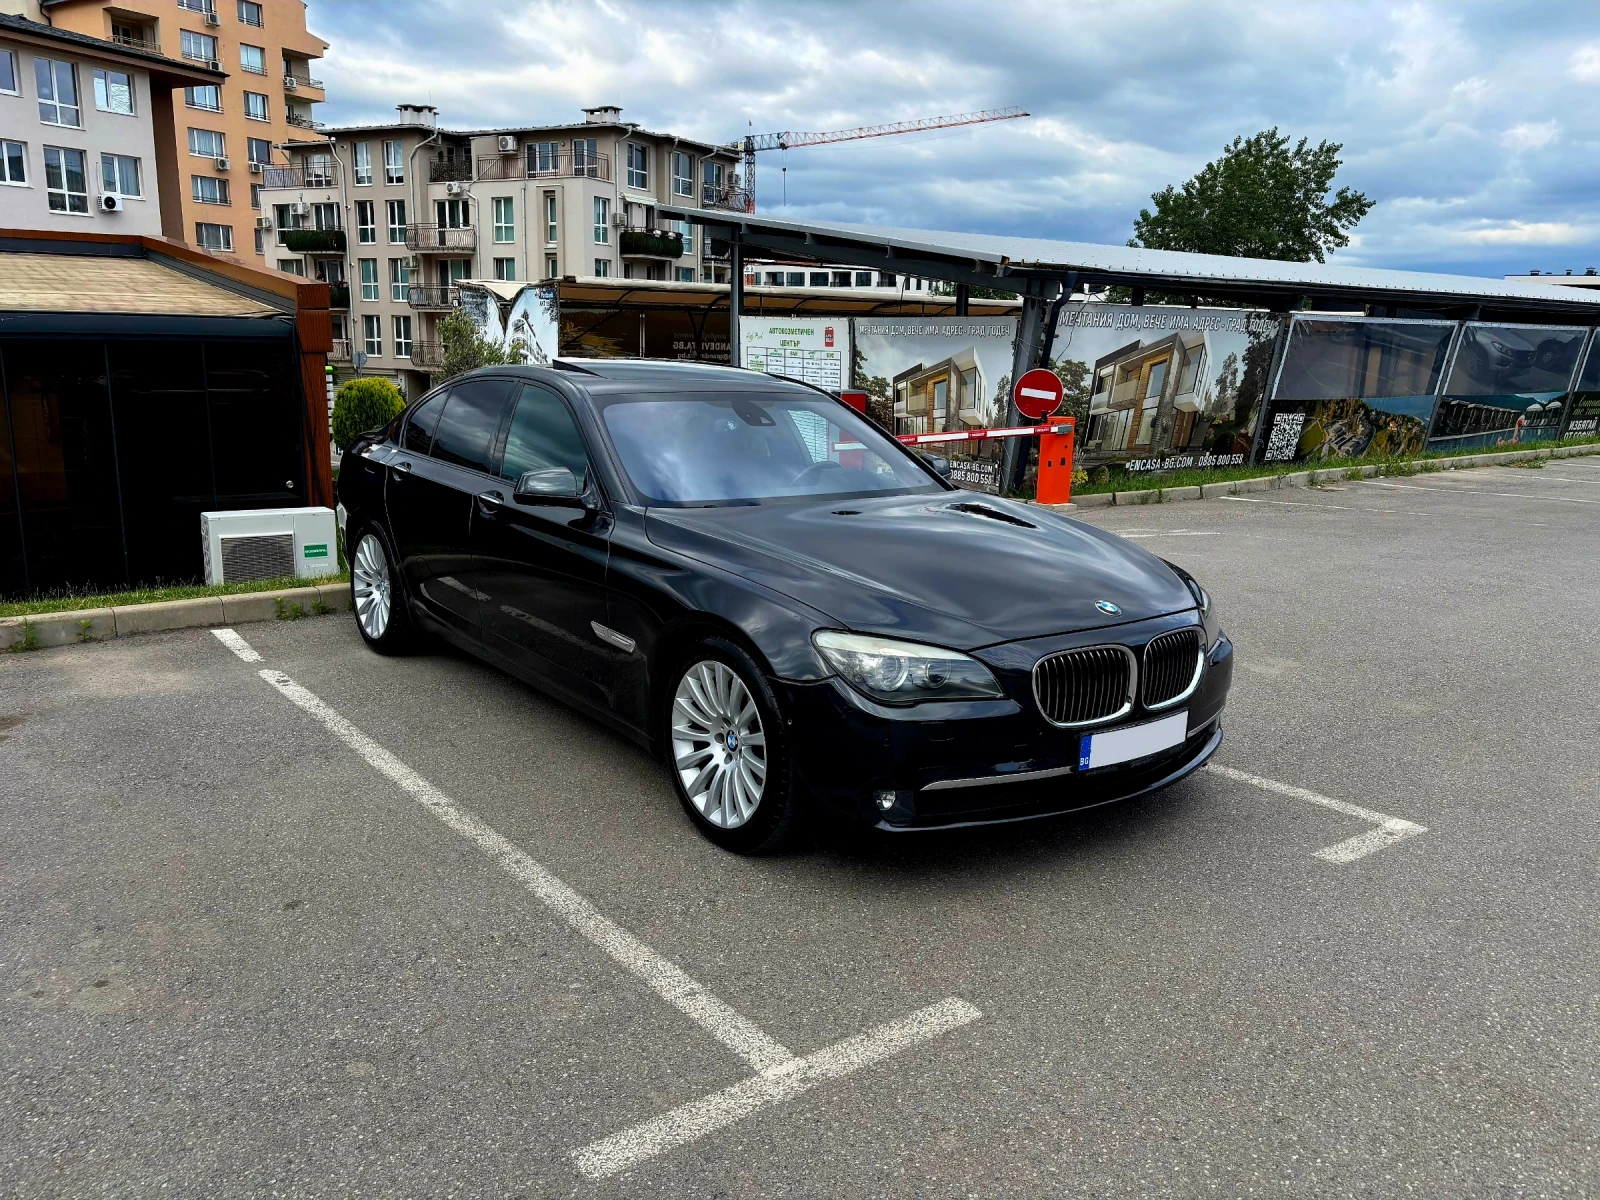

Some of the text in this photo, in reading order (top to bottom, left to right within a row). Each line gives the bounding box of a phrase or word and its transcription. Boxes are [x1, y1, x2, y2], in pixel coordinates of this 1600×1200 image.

[1058, 310, 1114, 327] МЕЧТАНИЯ
[1115, 314, 1142, 331] ДОМ,
[1143, 314, 1166, 329] ВЕЧЕ
[1169, 315, 1190, 330] ИМА
[859, 325, 889, 336] МЕЧТАНИЯ
[907, 325, 923, 336] ВЕЧЕ
[925, 325, 939, 336] ИМА
[988, 325, 1011, 338] ГОДЕЧ
[779, 339, 801, 348] ЦЕНТЪР
[1568, 417, 1598, 430] ИЗБЯГАЙ
[949, 460, 992, 473] ENCASA-BG.COM
[1129, 456, 1194, 471] ENCASA-BG.COM
[1198, 455, 1217, 467] 0885
[1217, 454, 1230, 465] 800
[1230, 453, 1244, 465] 558
[966, 472, 979, 483] 800
[980, 475, 991, 485] 558
[1079, 756, 1089, 766] BG
